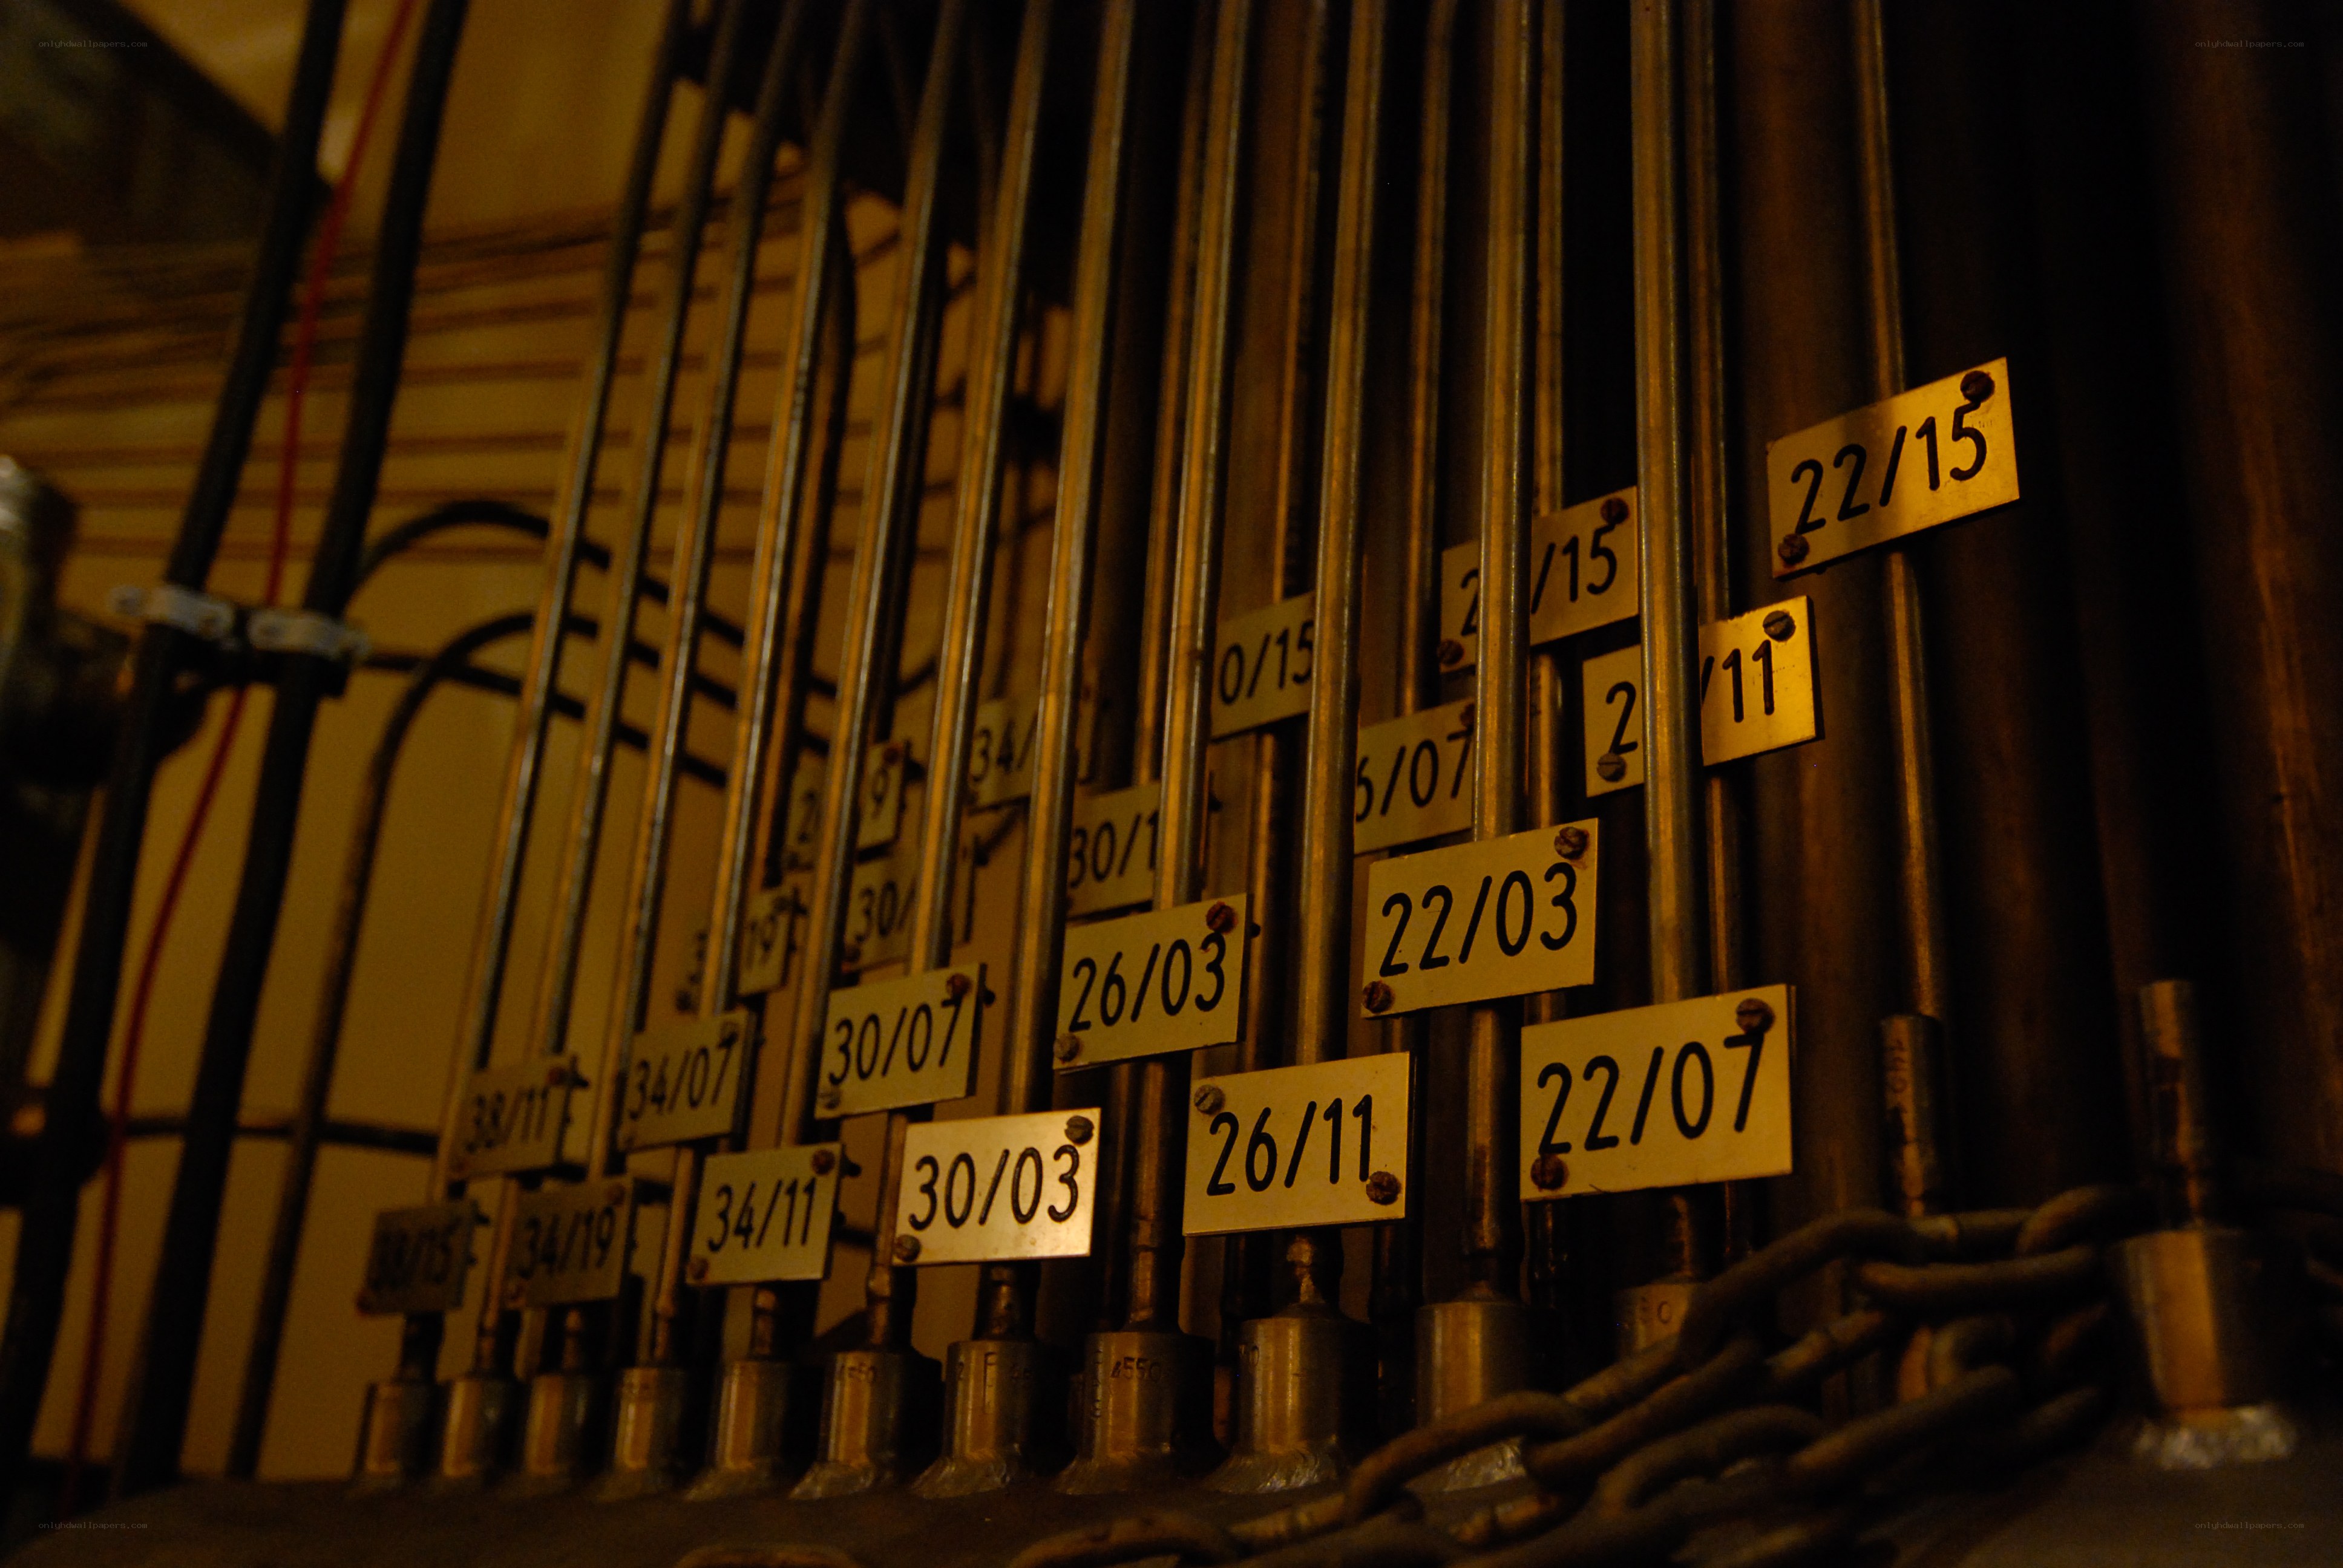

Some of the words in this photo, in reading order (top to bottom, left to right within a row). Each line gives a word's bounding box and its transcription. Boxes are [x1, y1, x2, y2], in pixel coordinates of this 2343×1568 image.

[1792, 400, 1987, 534] 22/15
[1461, 521, 1617, 636] 2/15
[1605, 639, 1774, 754] 2/11
[1380, 862, 1577, 977] 22/03
[1069, 932, 1226, 1032] 26/03
[629, 1033, 736, 1120] 34/07
[830, 997, 965, 1086] 30/07
[1537, 1031, 1765, 1154] 22/07
[909, 1145, 1080, 1230] 30/03
[1206, 1094, 1373, 1196] 26/11
[517, 1207, 617, 1278] 34/19
[707, 1177, 816, 1252] 34/11
